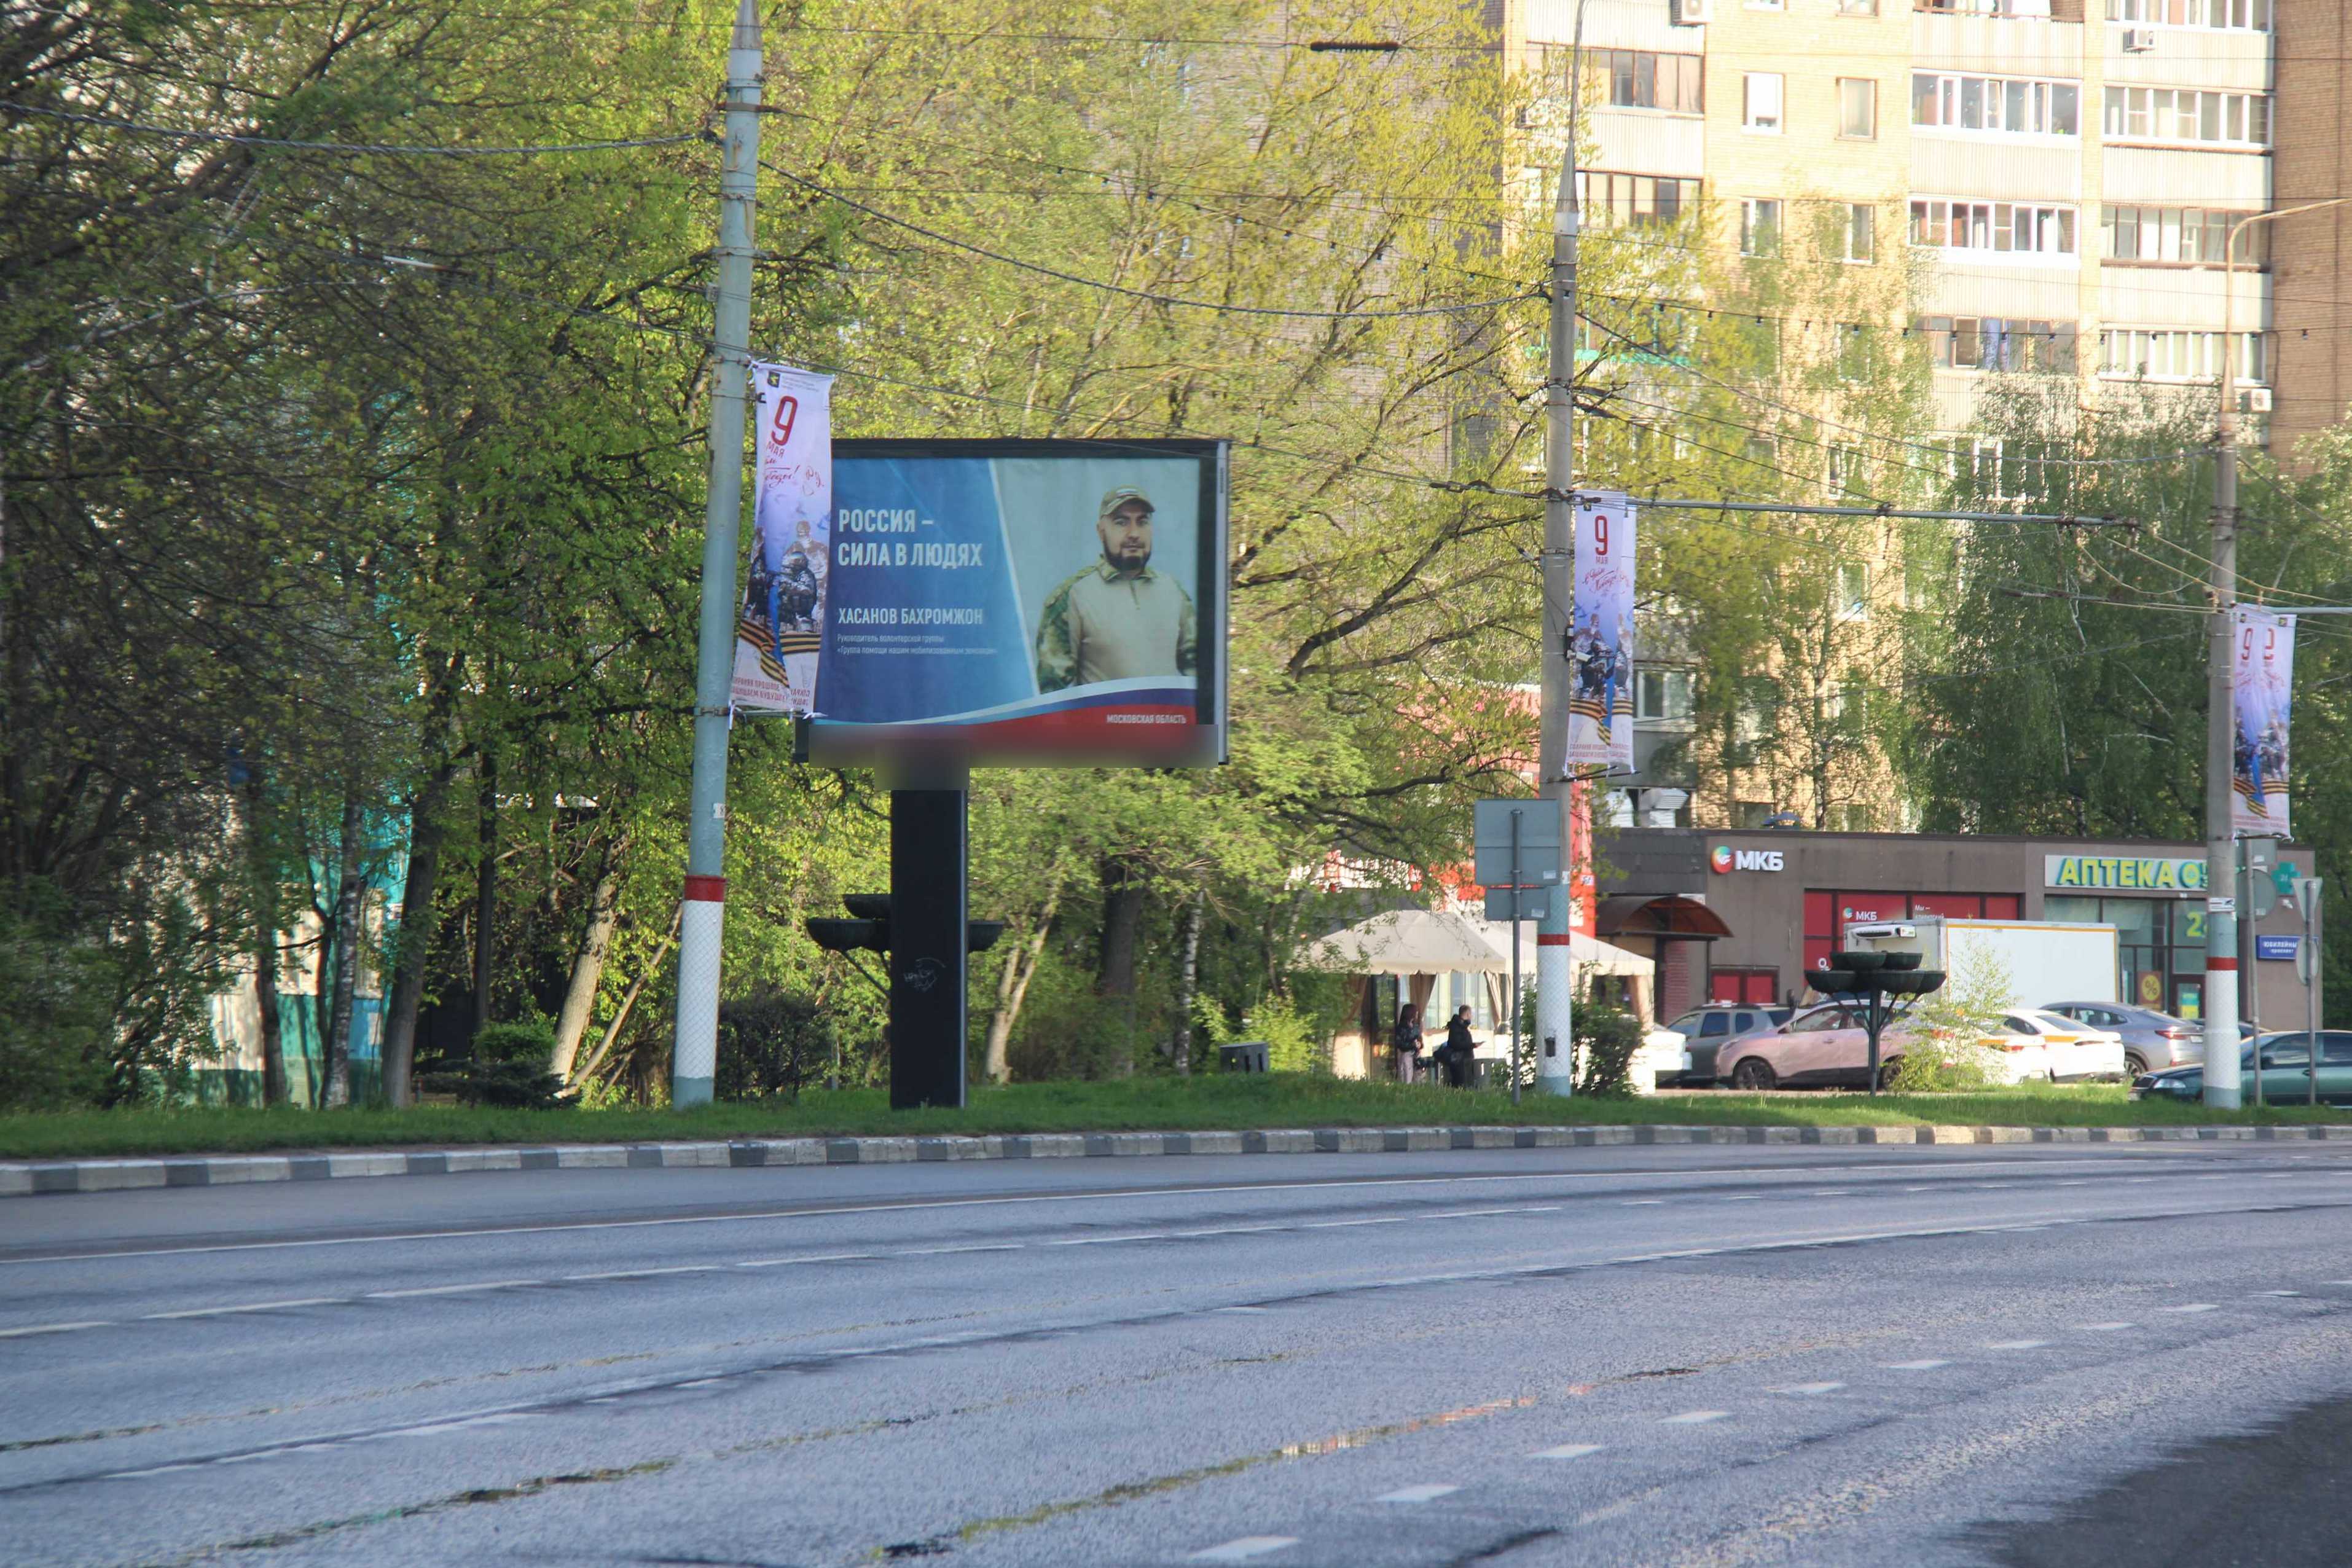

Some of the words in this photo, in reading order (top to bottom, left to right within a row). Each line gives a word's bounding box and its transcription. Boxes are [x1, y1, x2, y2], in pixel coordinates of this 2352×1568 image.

[771, 395, 798, 447] 9
[839, 509, 916, 532] РОССИЯ
[1594, 515, 1608, 555] 9
[837, 543, 891, 566] СИЛА
[895, 543, 907, 566] В
[911, 543, 982, 569] ЛЮДЯХ
[838, 608, 898, 624] ХАСАНОВ
[901, 608, 984, 625] БАХРОМЖОН
[837, 633, 879, 643] Руководитель
[1107, 714, 1154, 723] МОСКОВСКАЯ
[1155, 715, 1186, 724] ОБЛАСТЬ
[1735, 850, 1784, 871] МКБ
[2056, 858, 2177, 887] АПТЕКА
[1856, 911, 1878, 921] МКБ
[2187, 912, 2207, 937] 2
